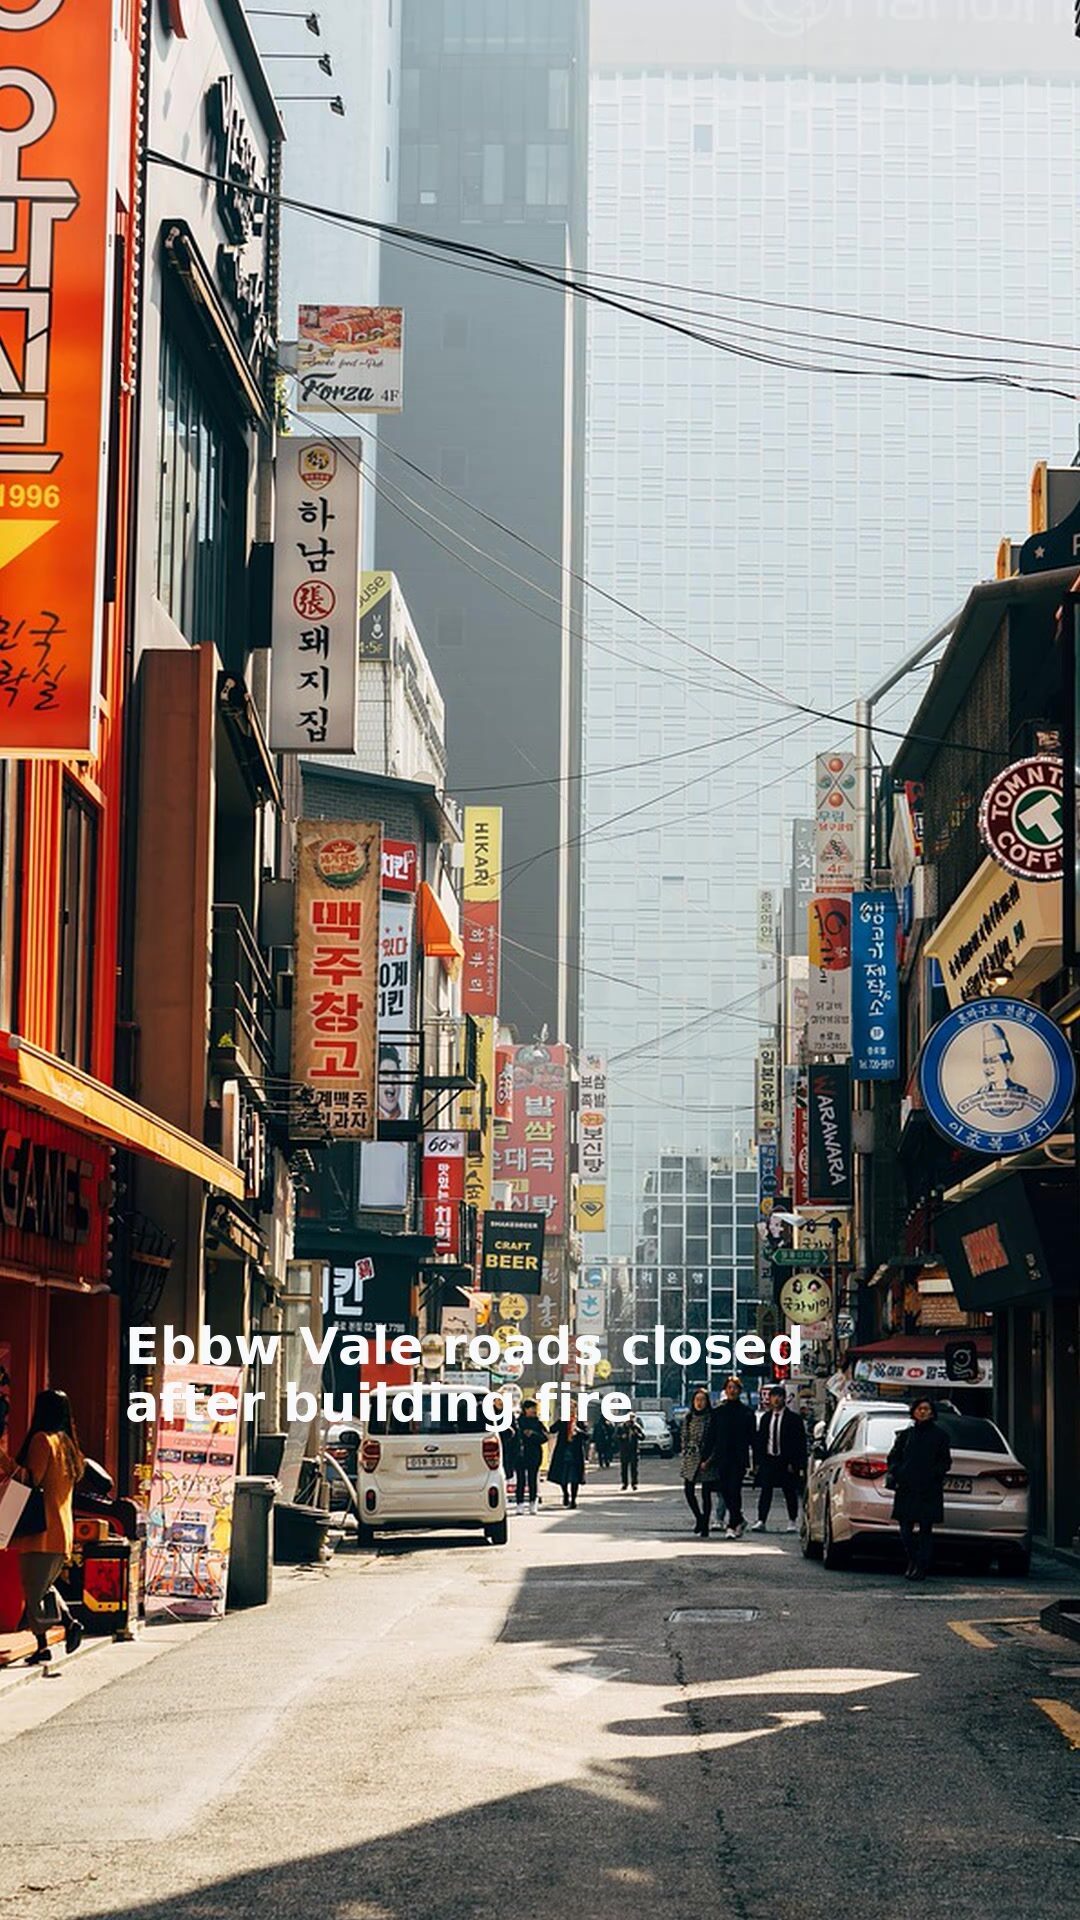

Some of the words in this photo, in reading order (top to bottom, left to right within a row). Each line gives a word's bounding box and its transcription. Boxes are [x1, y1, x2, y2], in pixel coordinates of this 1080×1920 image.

[300, 372, 374, 402] Forza
[380, 389, 399, 401] 4F
[474, 822, 489, 887] HIKARI
[308, 900, 363, 1078] 맥주창고
[583, 1127, 605, 1174] 보신탕
[813, 1072, 848, 1187] WARAWARA
[485, 1253, 539, 1271] BEER
[494, 1240, 532, 1251] CRAFT
